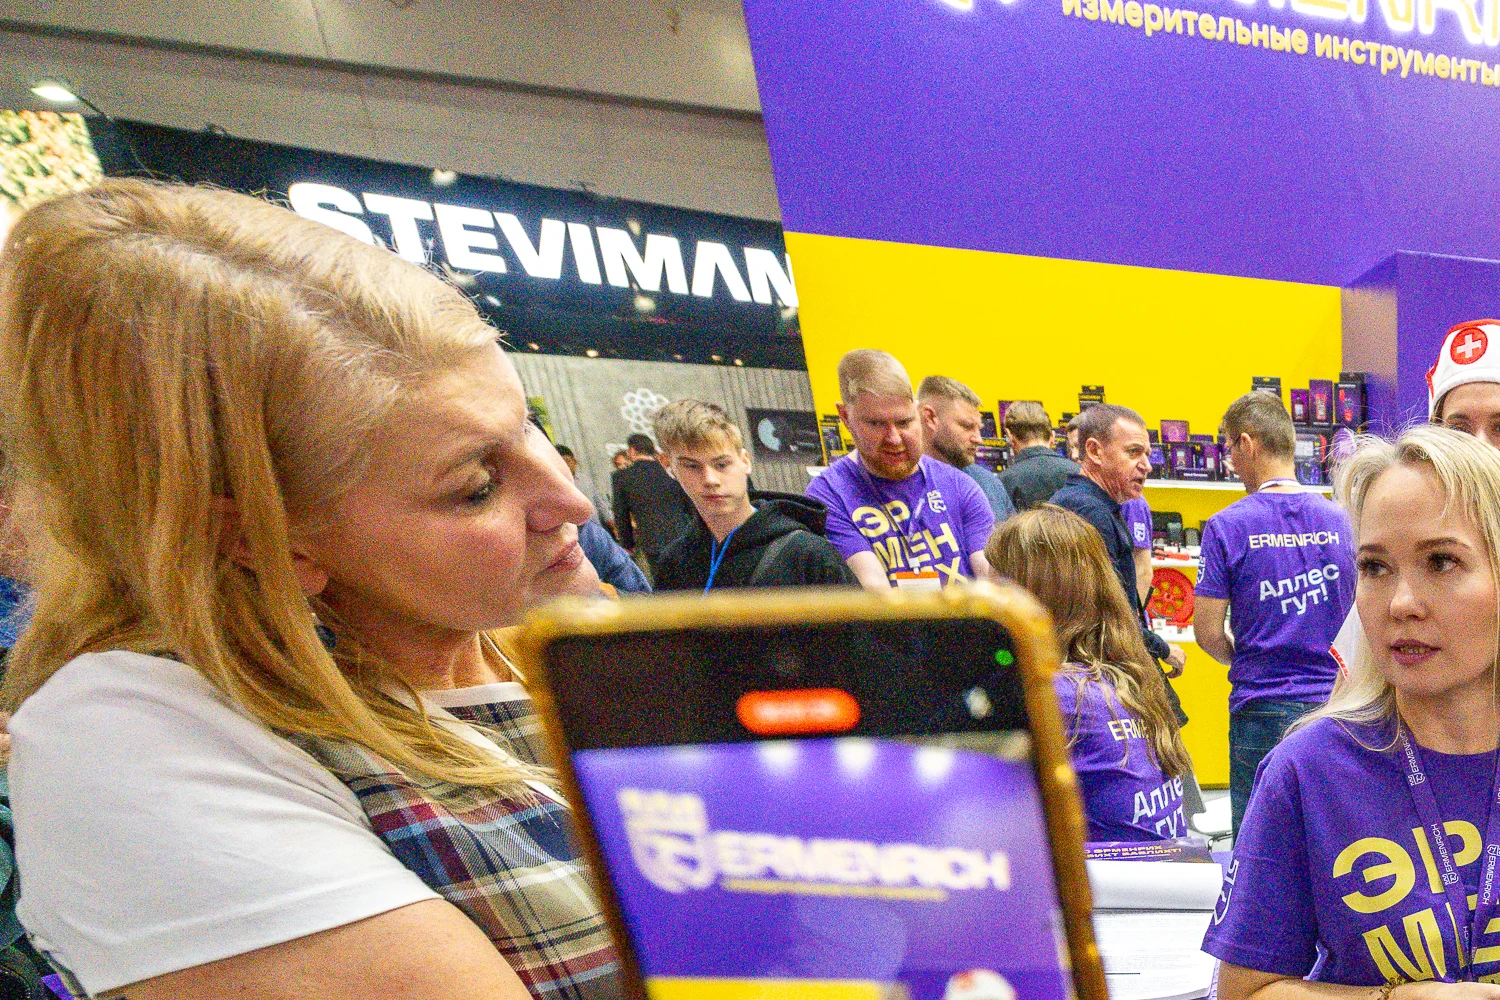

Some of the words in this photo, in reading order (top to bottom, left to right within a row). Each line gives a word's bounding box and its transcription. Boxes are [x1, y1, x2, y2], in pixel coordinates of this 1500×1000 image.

[1314, 32, 1500, 87] инструменты
[1248, 530, 1340, 549] ERMENRICH
[1259, 563, 1340, 602] Аллес
[1280, 582, 1330, 616] гут!
[1333, 820, 1484, 914] ЭР
[1431, 823, 1453, 874] ERMENRICH
[1482, 855, 1498, 905] ERMENRICH
